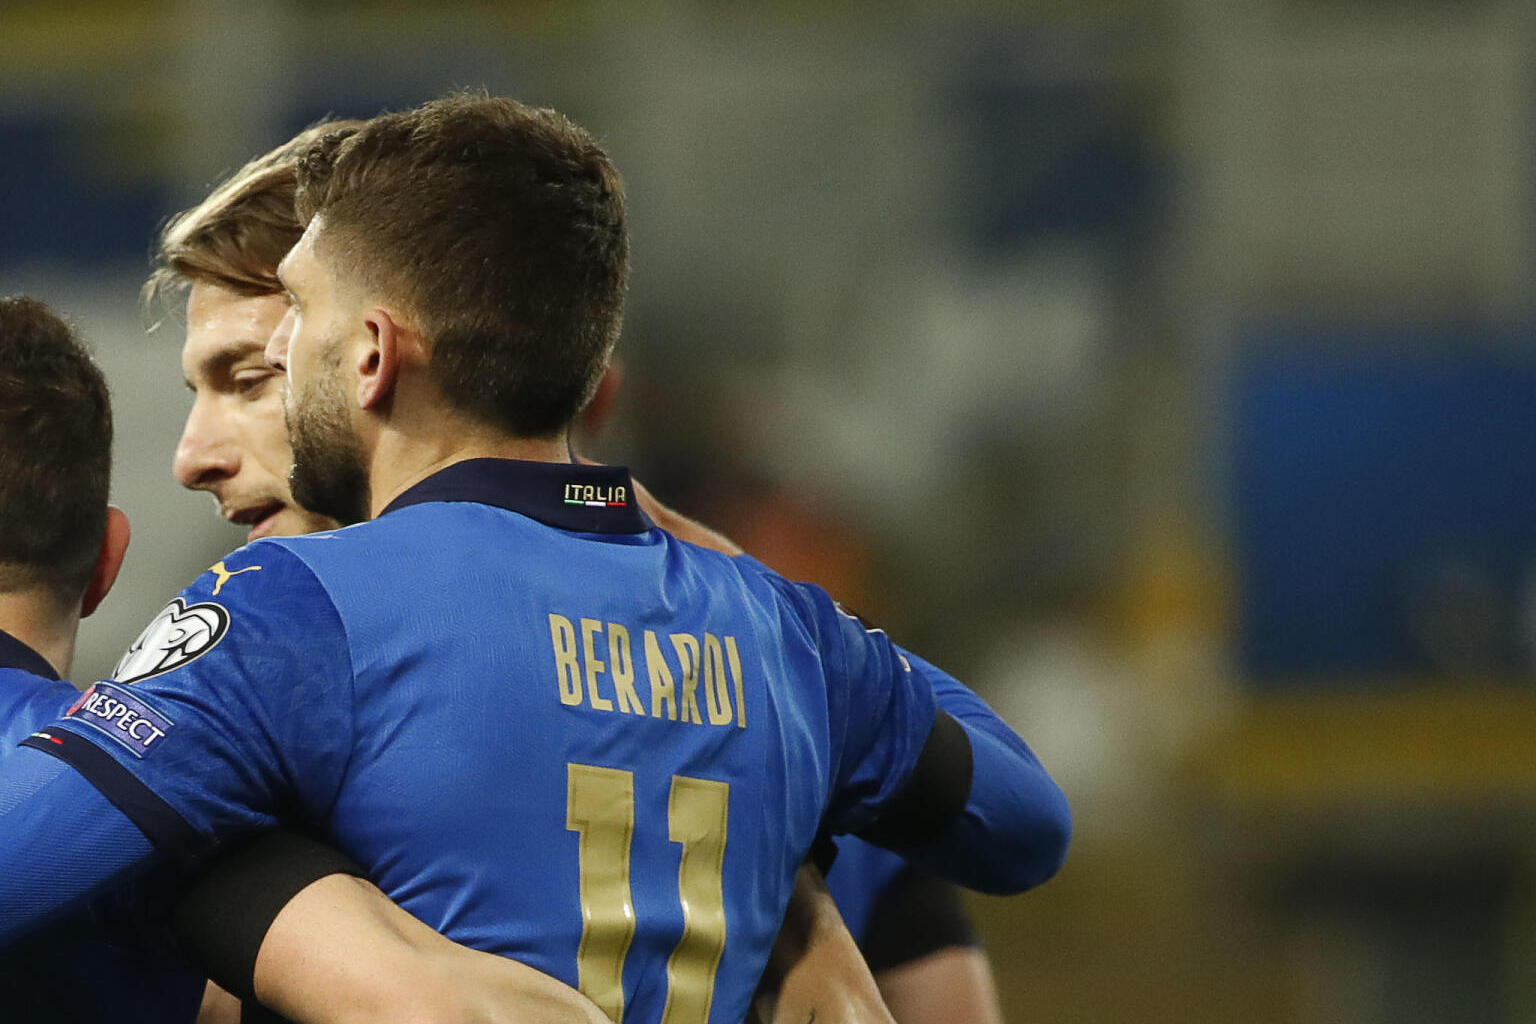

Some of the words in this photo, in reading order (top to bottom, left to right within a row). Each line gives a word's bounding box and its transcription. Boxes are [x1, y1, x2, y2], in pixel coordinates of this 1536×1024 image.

[564, 484, 626, 502] ITALIA
[549, 613, 747, 728] BERARDI
[81, 692, 166, 746] RESPECT
